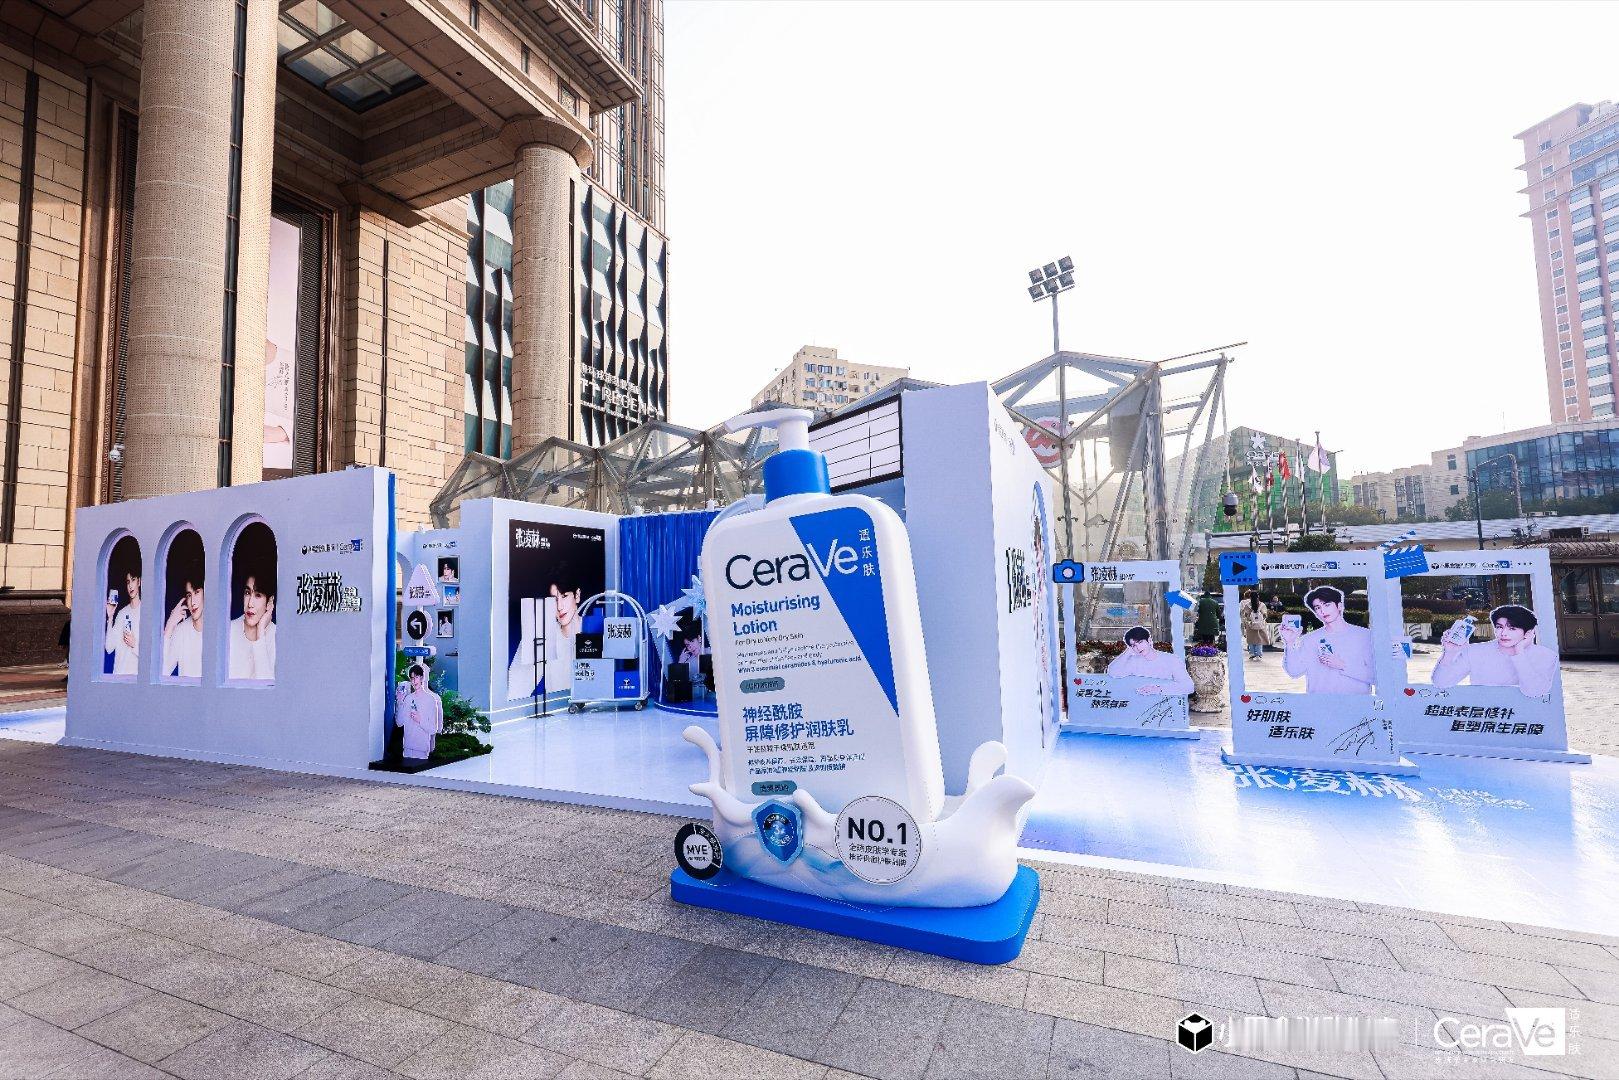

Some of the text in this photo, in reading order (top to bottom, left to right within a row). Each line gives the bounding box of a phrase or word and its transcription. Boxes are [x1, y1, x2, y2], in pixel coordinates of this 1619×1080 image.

[858, 528, 876, 577] 适乐肤
[725, 538, 859, 590] CeraVe
[731, 595, 821, 618] Moisturising
[733, 619, 778, 636] Lotion
[743, 702, 804, 724] 神经酰胺
[1246, 709, 1292, 723] 好肌肤
[1424, 704, 1515, 720] 超越表层修补
[745, 718, 855, 743] 屏障修护润肤乳
[1268, 725, 1316, 740] 适乐肤
[1450, 719, 1545, 736] 重塑原生屏障
[848, 816, 907, 845] NO.1
[686, 844, 708, 855] MVE
[849, 843, 907, 858] 全球皮肤学专家
